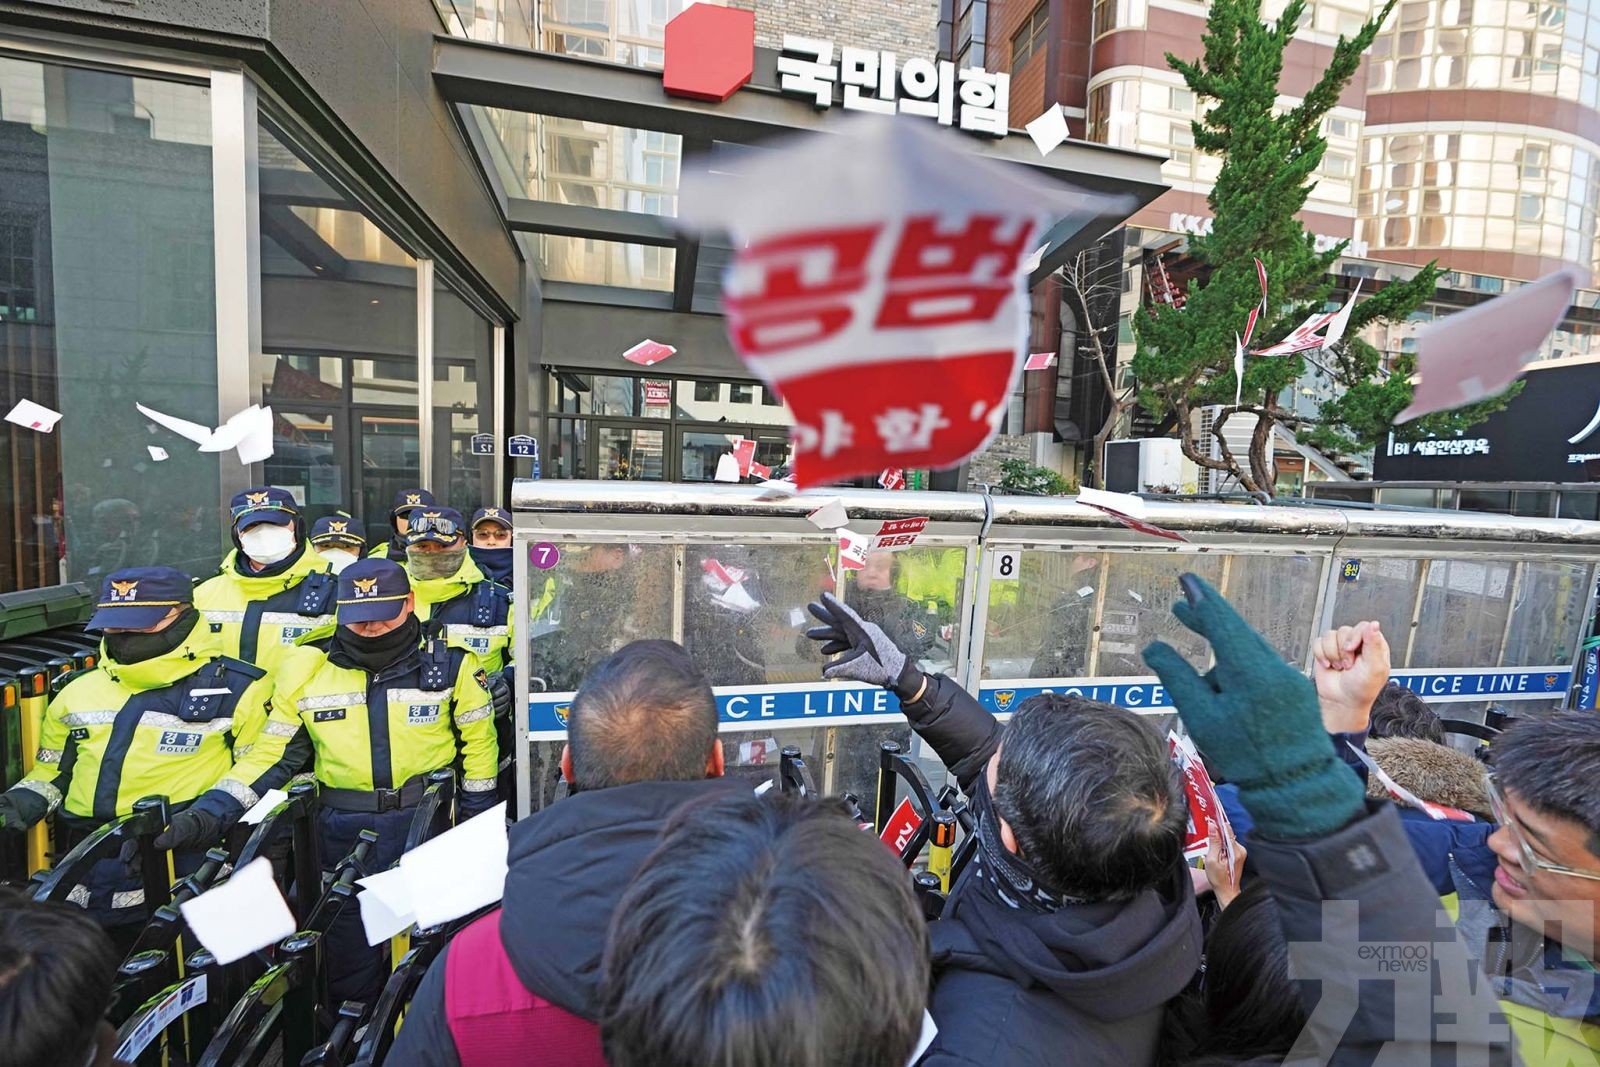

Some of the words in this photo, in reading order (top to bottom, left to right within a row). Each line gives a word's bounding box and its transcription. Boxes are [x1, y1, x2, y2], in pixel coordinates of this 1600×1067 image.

[777, 34, 1010, 136] 국민의힘
[517, 445, 529, 455] 12
[538, 547, 551, 564] 7
[1000, 555, 1013, 576] 8
[1390, 676, 1462, 694] LICE
[1476, 674, 1528, 693] LINE
[804, 690, 888, 716] LINE
[1041, 685, 1164, 707] LICE
[411, 706, 437, 717] 경찰
[164, 732, 200, 746] 경찰
[159, 745, 196, 753] POLICE
